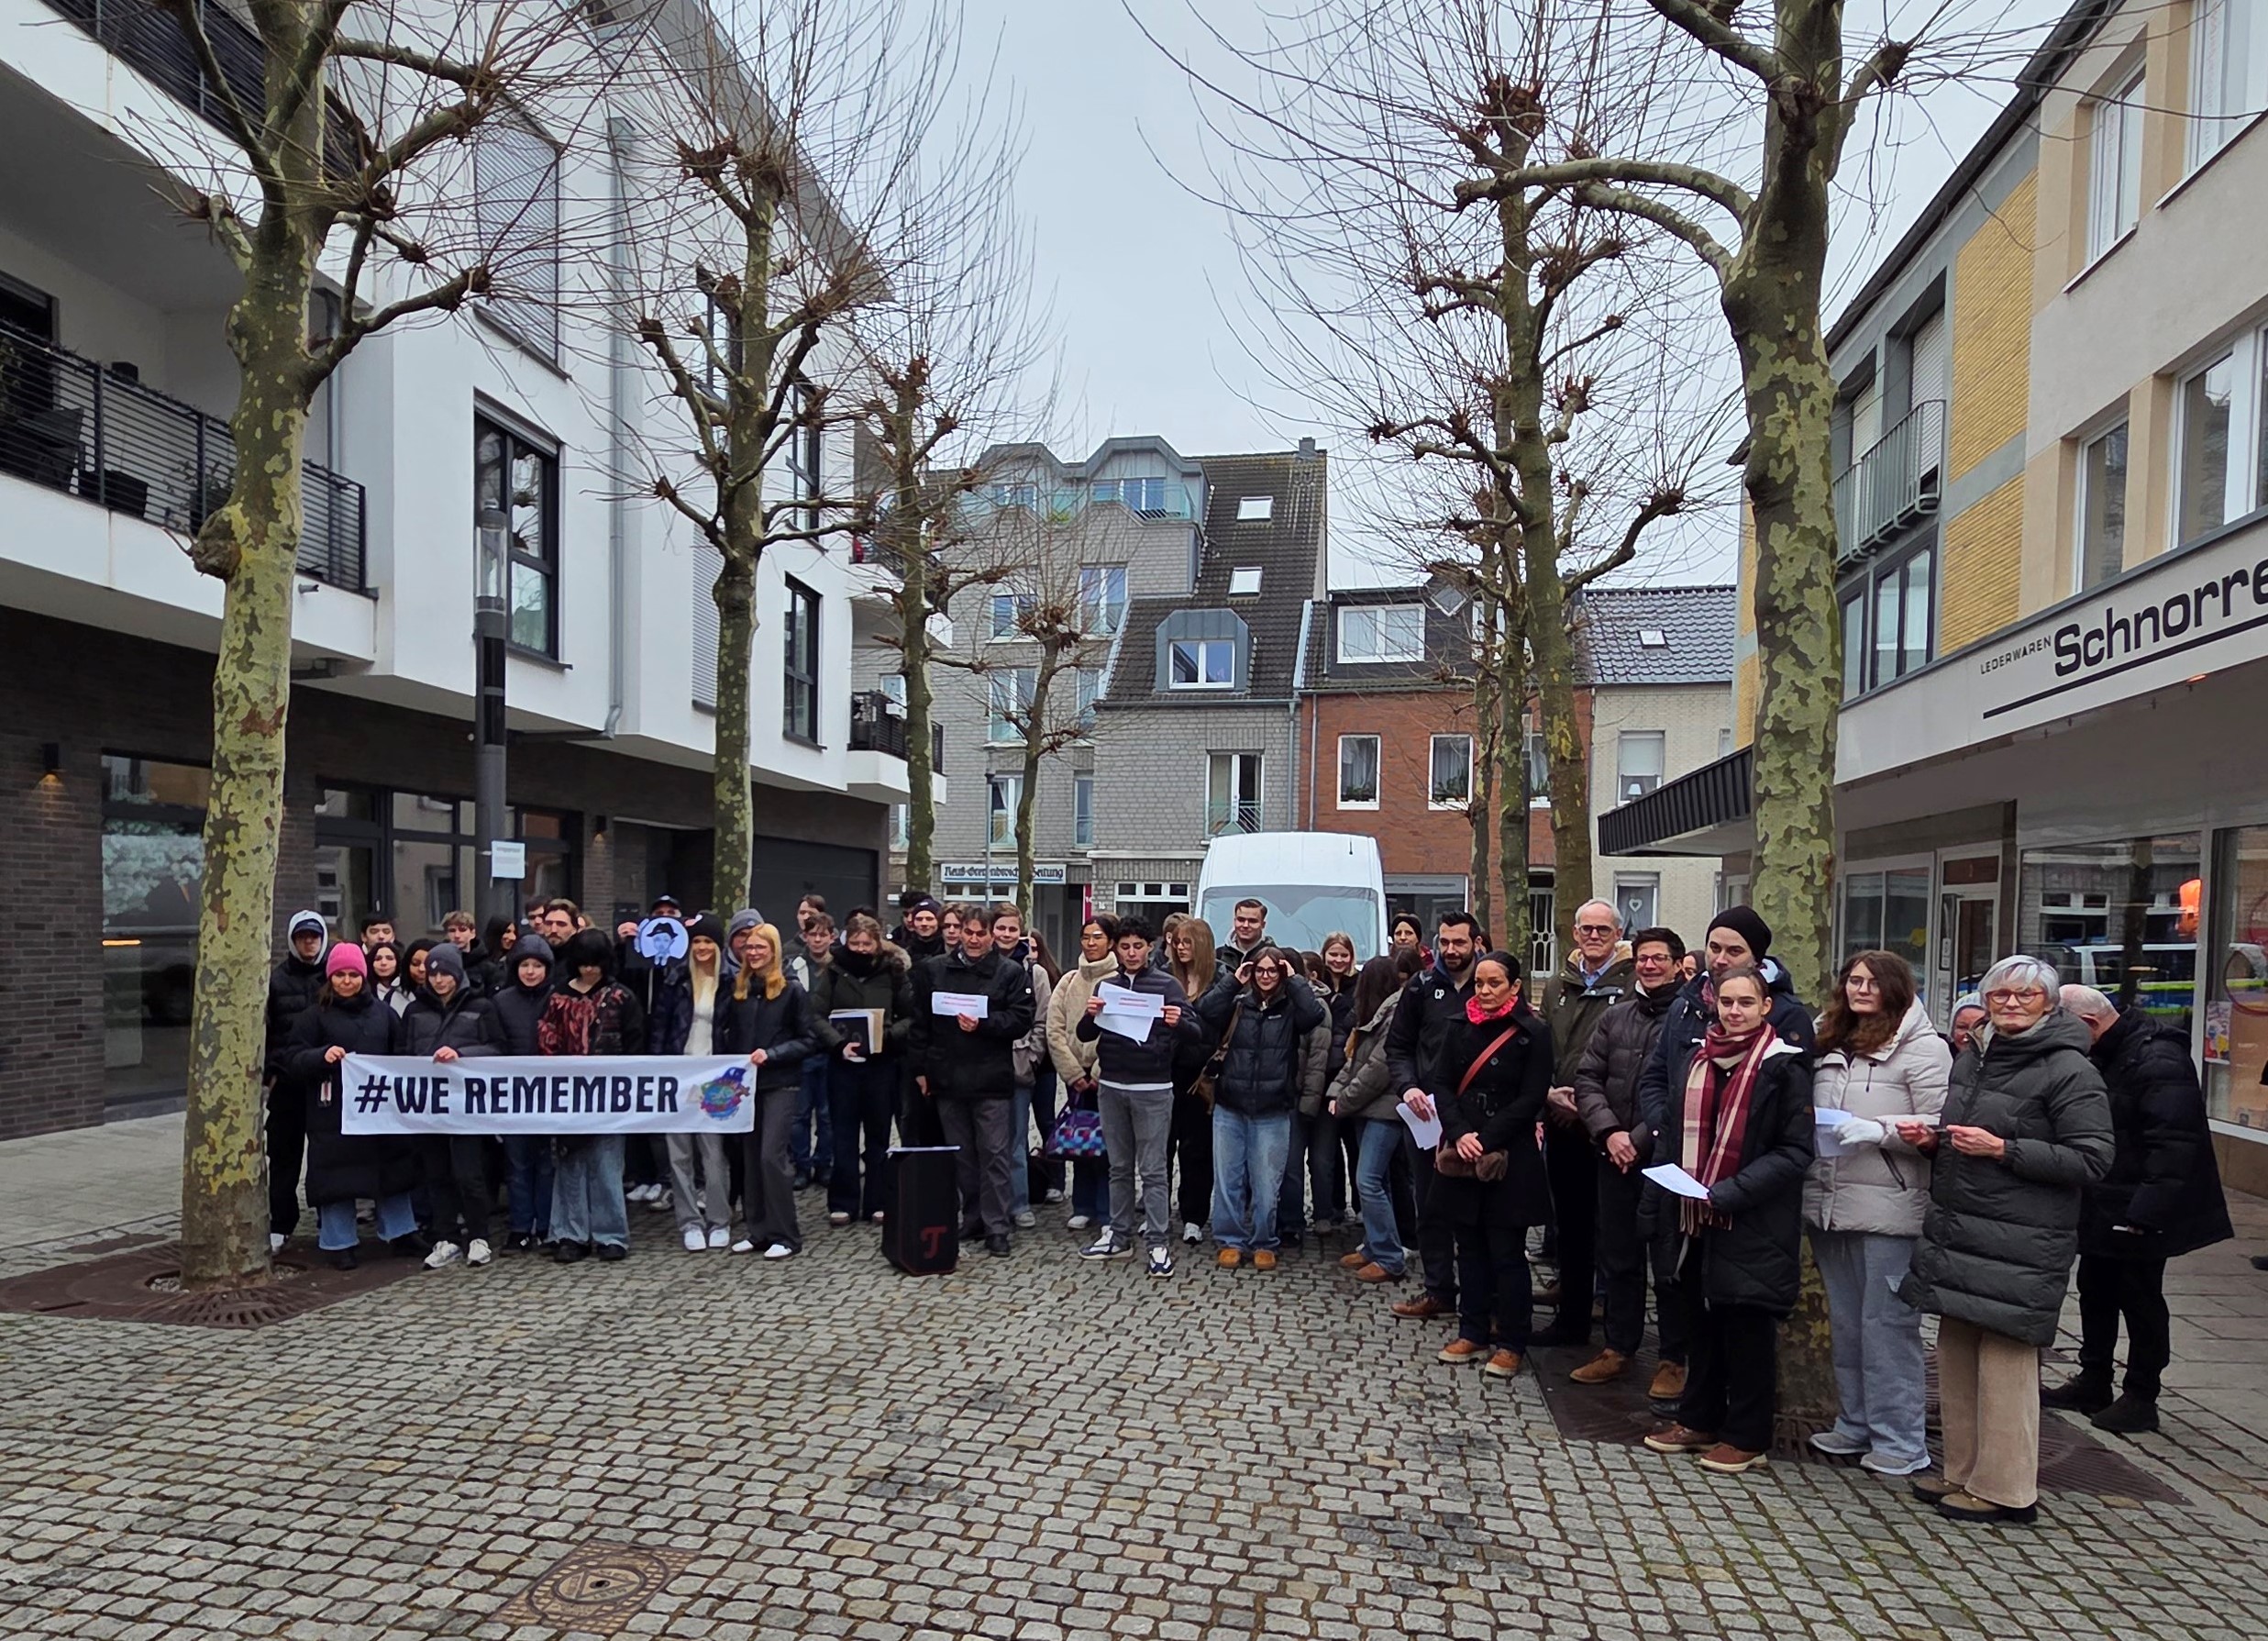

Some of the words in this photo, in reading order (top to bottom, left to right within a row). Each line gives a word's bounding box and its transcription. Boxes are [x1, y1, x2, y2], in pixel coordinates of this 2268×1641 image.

[1980, 635, 2052, 675] LEDERWAREN
[354, 1074, 450, 1114] #WE
[464, 1076, 680, 1114] REMEMBER
